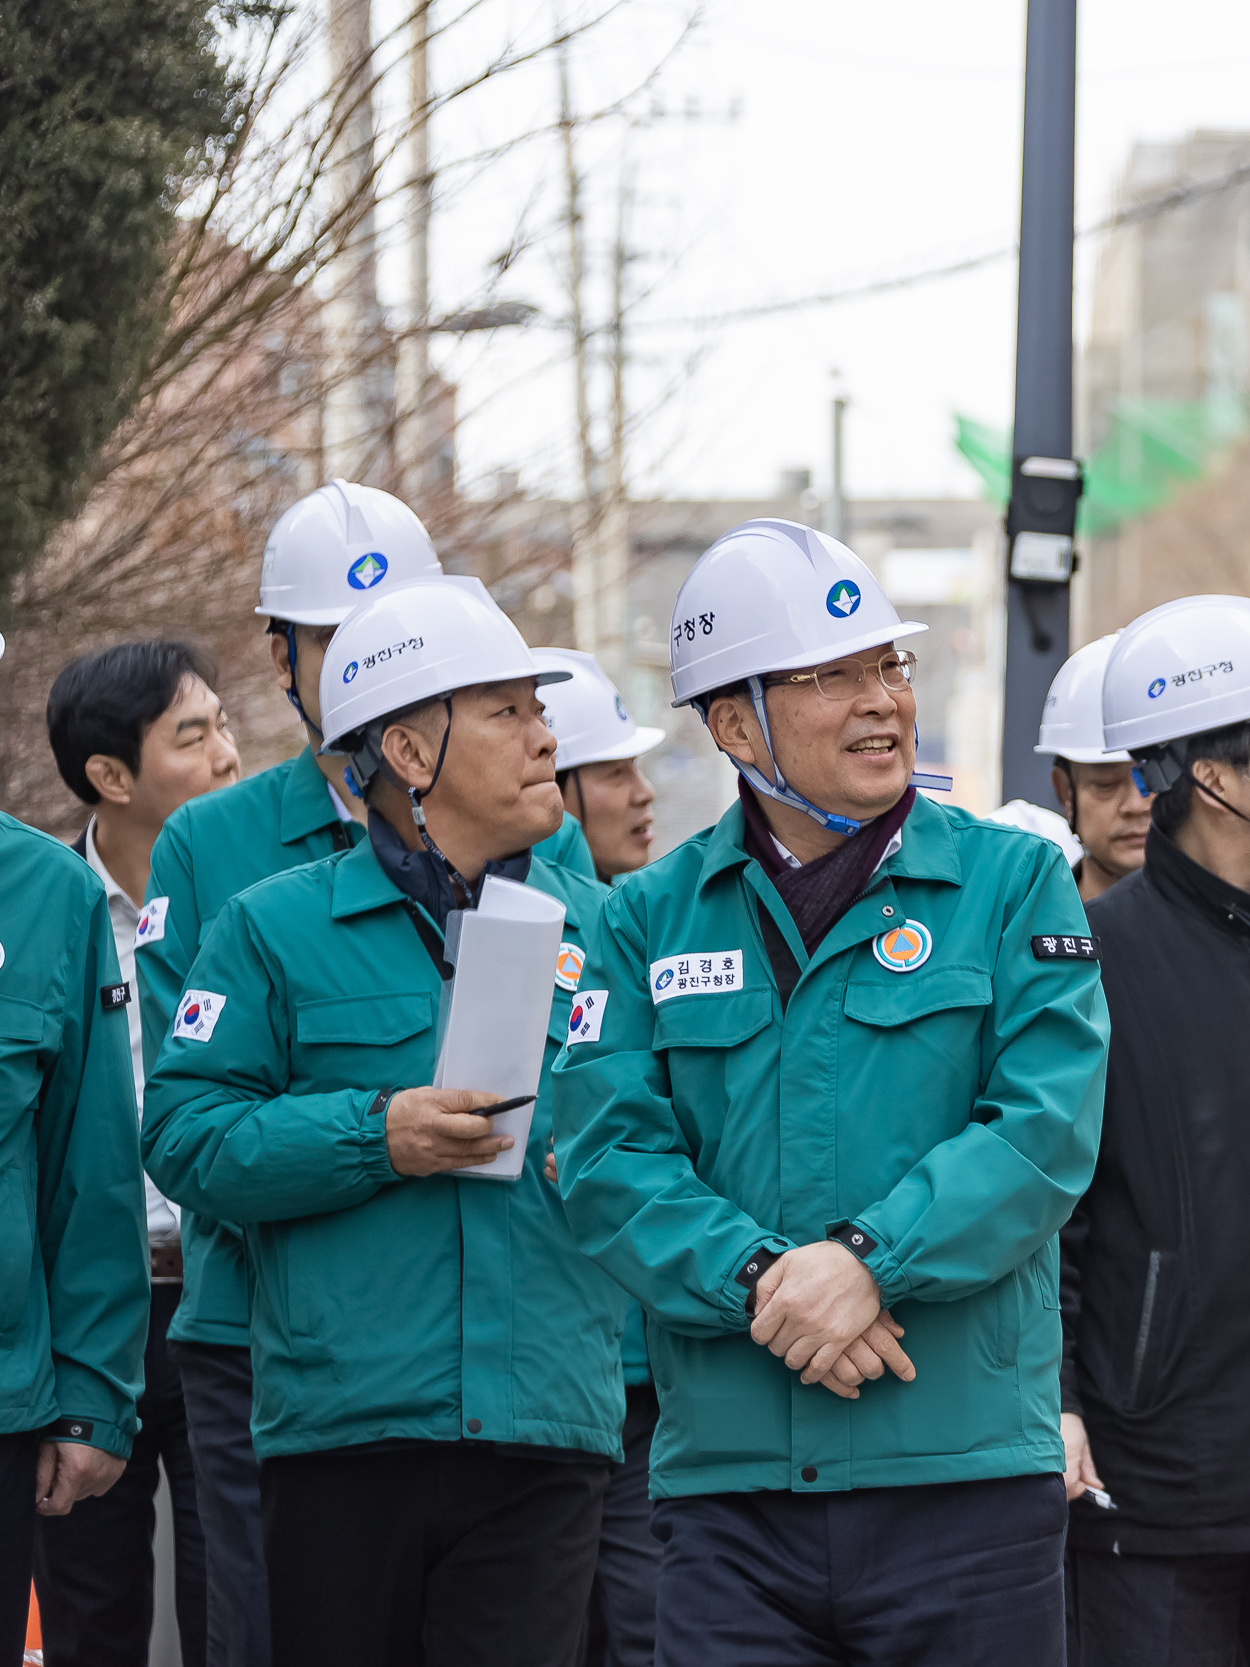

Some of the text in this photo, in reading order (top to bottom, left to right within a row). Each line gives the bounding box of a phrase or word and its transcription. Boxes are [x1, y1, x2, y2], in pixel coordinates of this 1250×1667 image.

[673, 611, 715, 648] 구청장
[361, 636, 424, 669] 광진구청
[1170, 660, 1233, 687] 광진구청
[1042, 936, 1094, 955] 광진구
[677, 973, 736, 990] 광진구청장
